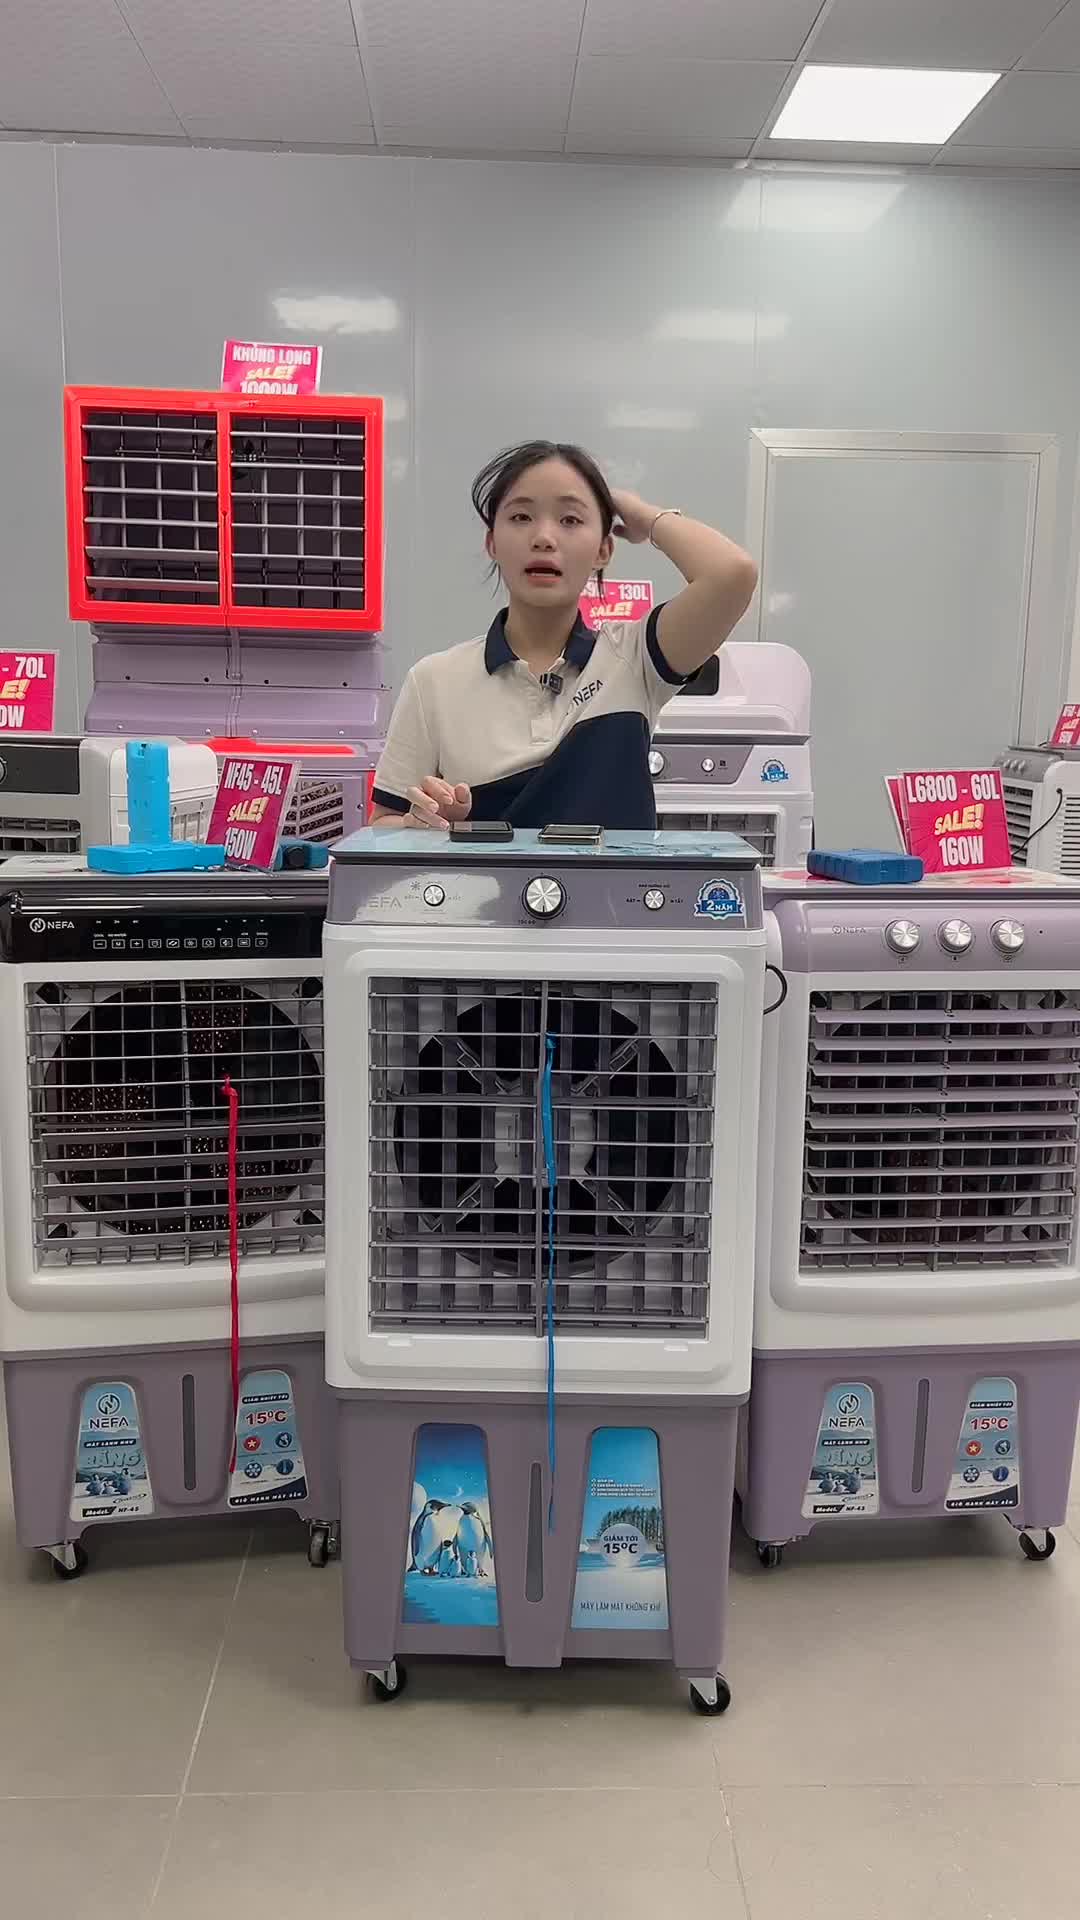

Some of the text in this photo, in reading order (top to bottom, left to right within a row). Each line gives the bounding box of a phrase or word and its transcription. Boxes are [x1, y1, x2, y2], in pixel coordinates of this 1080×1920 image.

[279, 349, 312, 365] LONG
[245, 365, 297, 381] SALE!
[240, 380, 298, 395] 1000W
[618, 583, 649, 601] 130L
[590, 601, 633, 618] SALE!
[15, 655, 47, 679] 70L
[224, 762, 255, 792] NF45
[260, 764, 285, 796] 45L
[905, 774, 958, 804] L6800
[970, 773, 1001, 800] 60L
[227, 797, 269, 823] SALE!
[934, 802, 985, 836] SALE!
[224, 826, 258, 861] 150W
[938, 835, 985, 867] 160W
[366, 896, 402, 908] EFA
[706, 900, 715, 911] 2
[47, 920, 76, 929] NEFA
[90, 1416, 129, 1429] NEFA
[829, 1417, 865, 1428] NEFA
